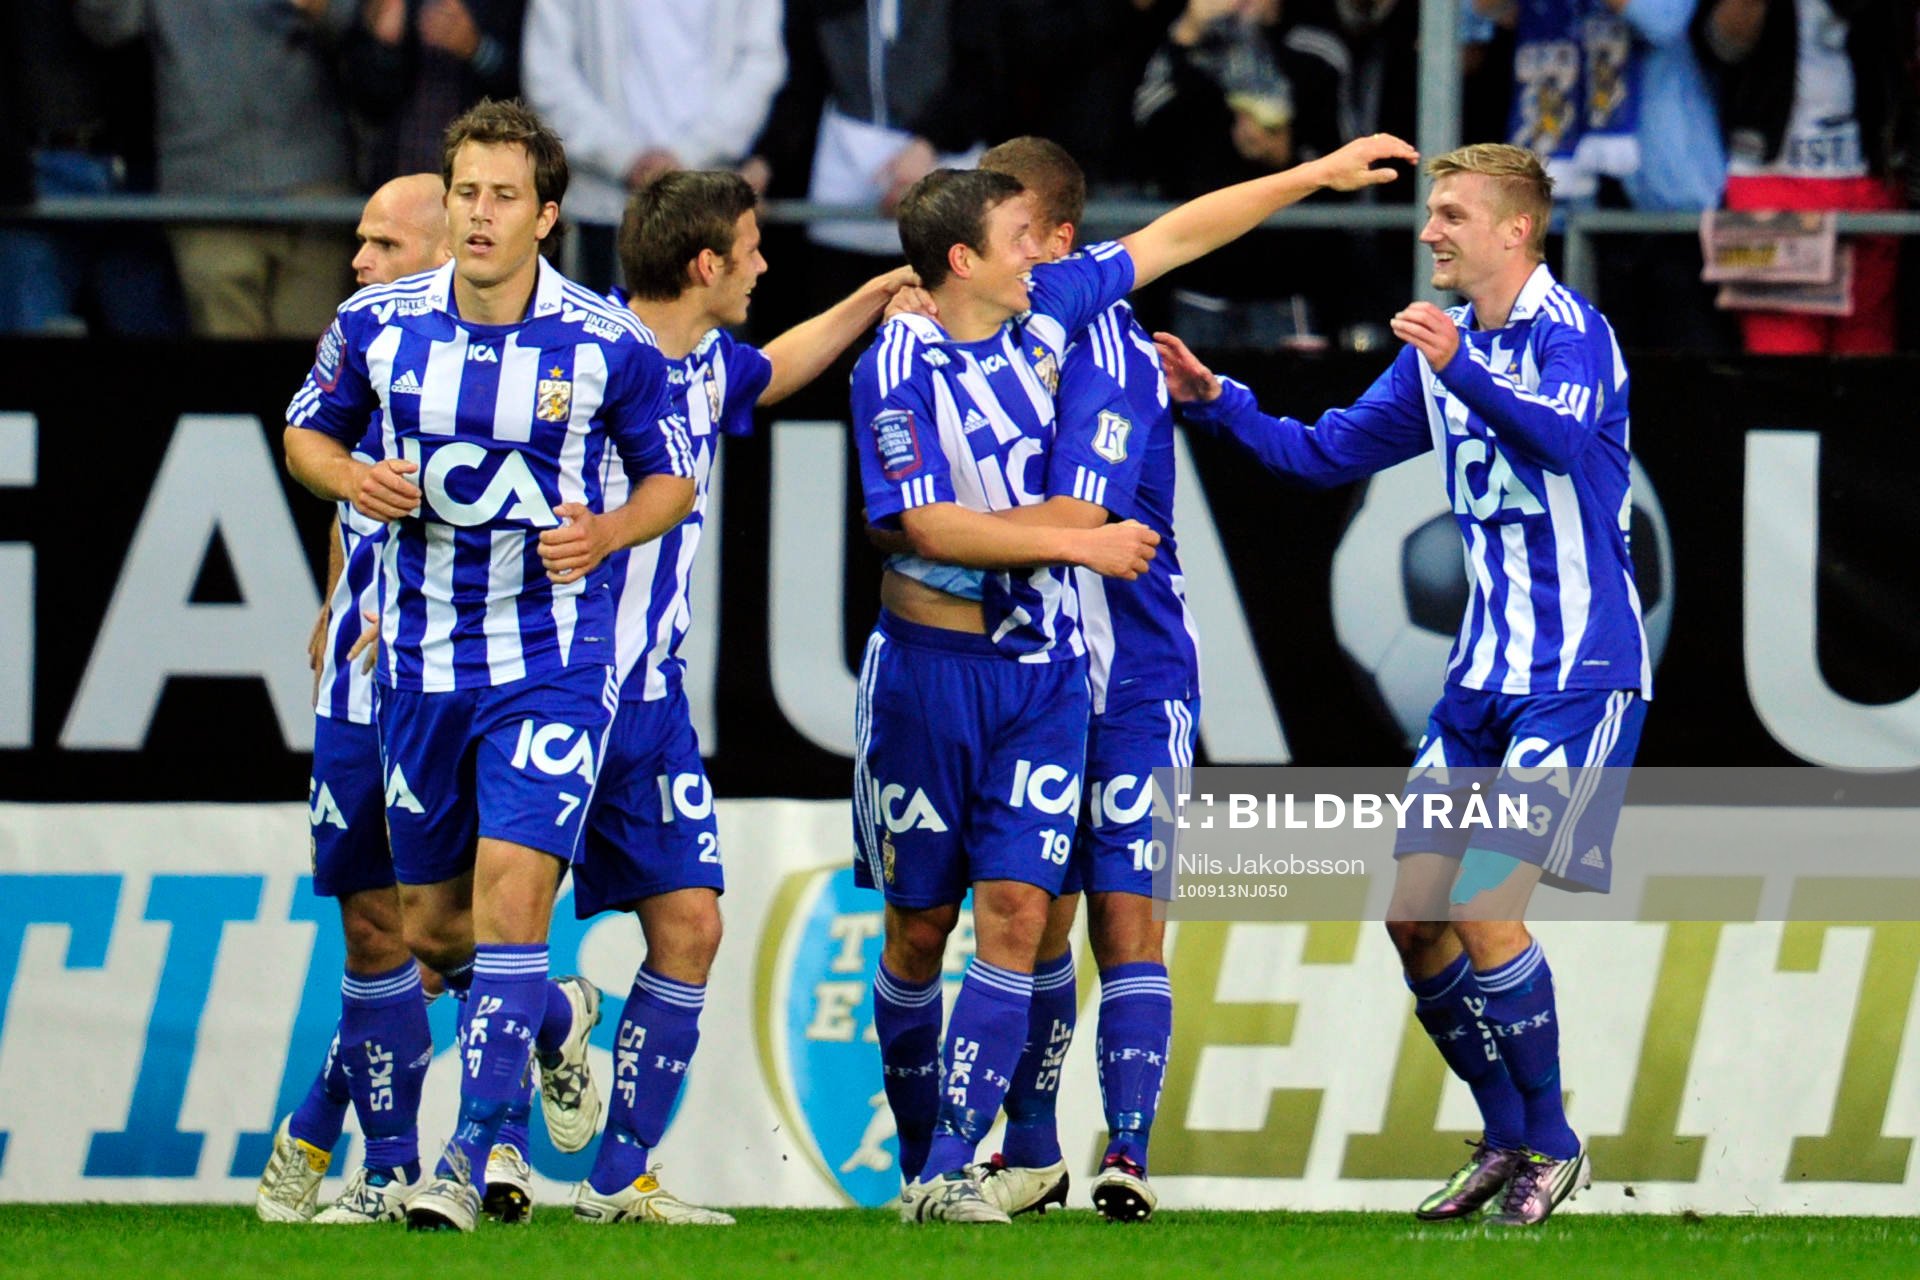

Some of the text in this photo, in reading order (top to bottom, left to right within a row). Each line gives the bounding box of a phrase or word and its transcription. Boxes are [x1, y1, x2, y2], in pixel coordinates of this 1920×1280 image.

[467, 344, 498, 363] ICA
[979, 352, 1009, 375] ICA
[1101, 418, 1124, 456] K
[402, 436, 560, 528] ICA
[511, 719, 596, 785] ICA
[555, 791, 581, 827] 7
[873, 778, 949, 833] ICA
[1009, 759, 1081, 827] ICA
[1091, 774, 1175, 828] ICA
[1039, 828, 1071, 866] 19
[1128, 838, 1167, 872] 10
[365, 1039, 394, 1113] SKF
[617, 1019, 647, 1109] SKF
[947, 1036, 980, 1108] SKF
